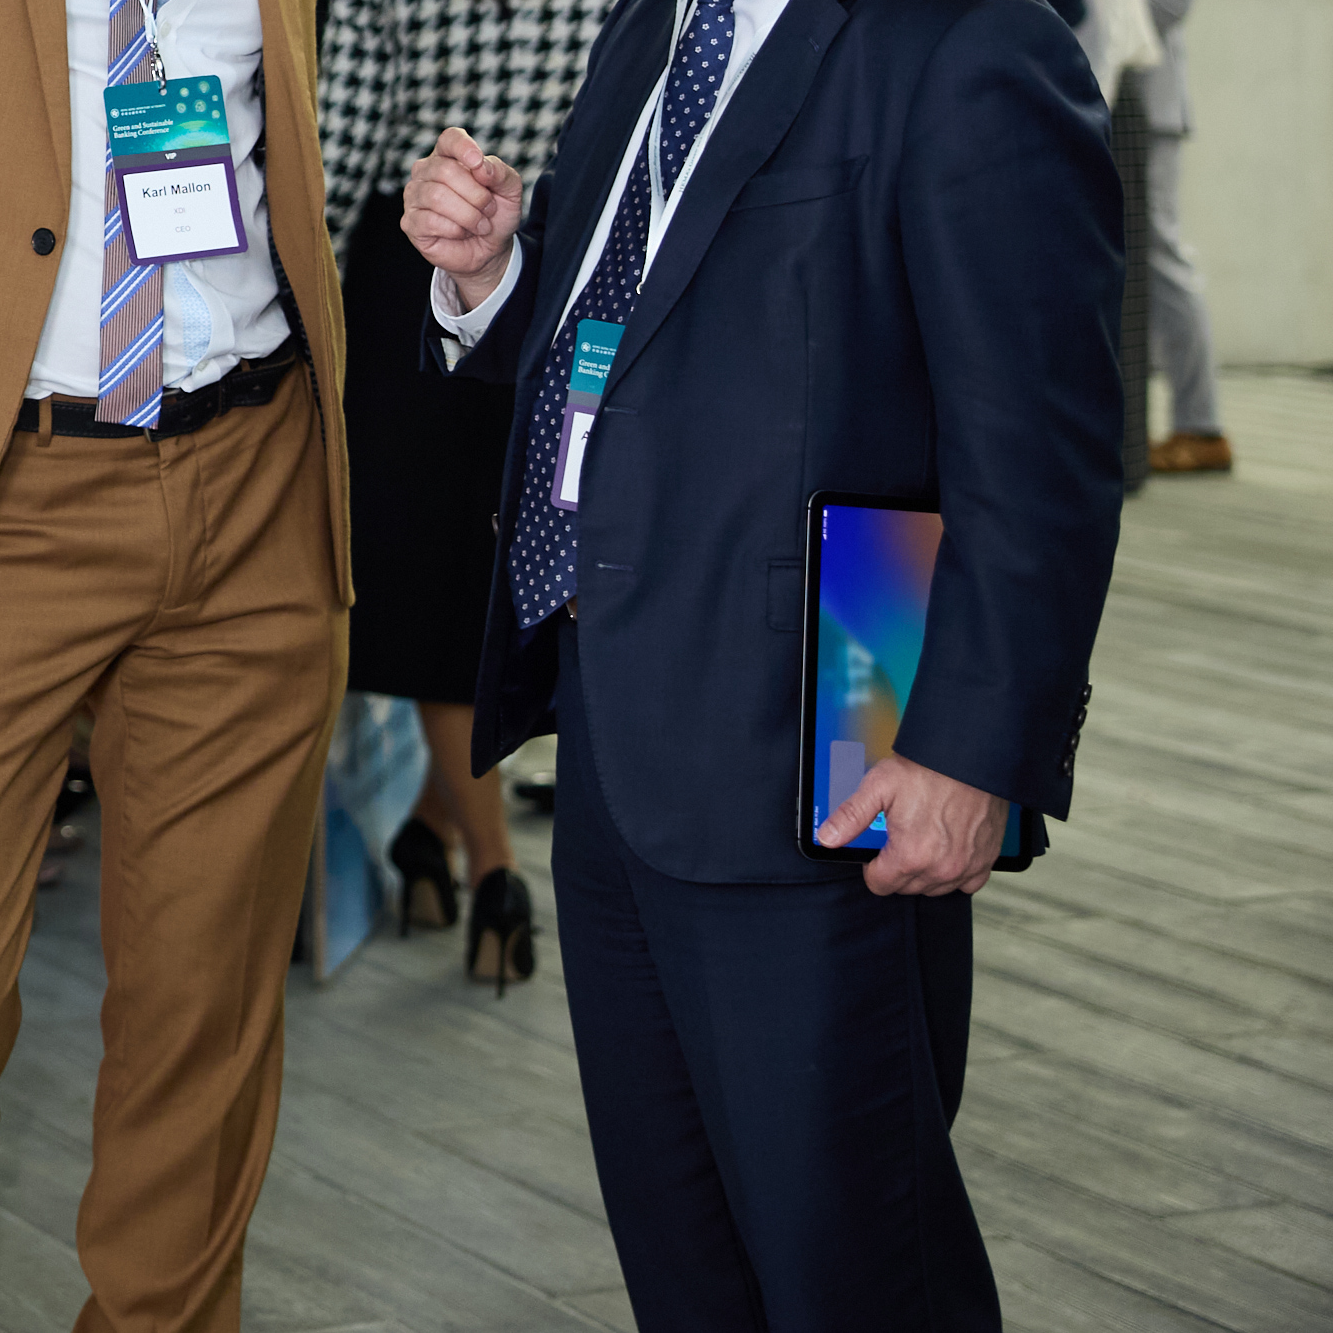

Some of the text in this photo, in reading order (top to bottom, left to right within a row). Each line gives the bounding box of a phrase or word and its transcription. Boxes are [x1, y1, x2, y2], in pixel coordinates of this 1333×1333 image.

[131, 122, 143, 130] and
[142, 119, 174, 129] Sustainable
[113, 127, 170, 139] Banking Conference
[142, 181, 212, 199] Karl Mallon
[579, 359, 598, 368] Green
[578, 366, 604, 379] Banking
